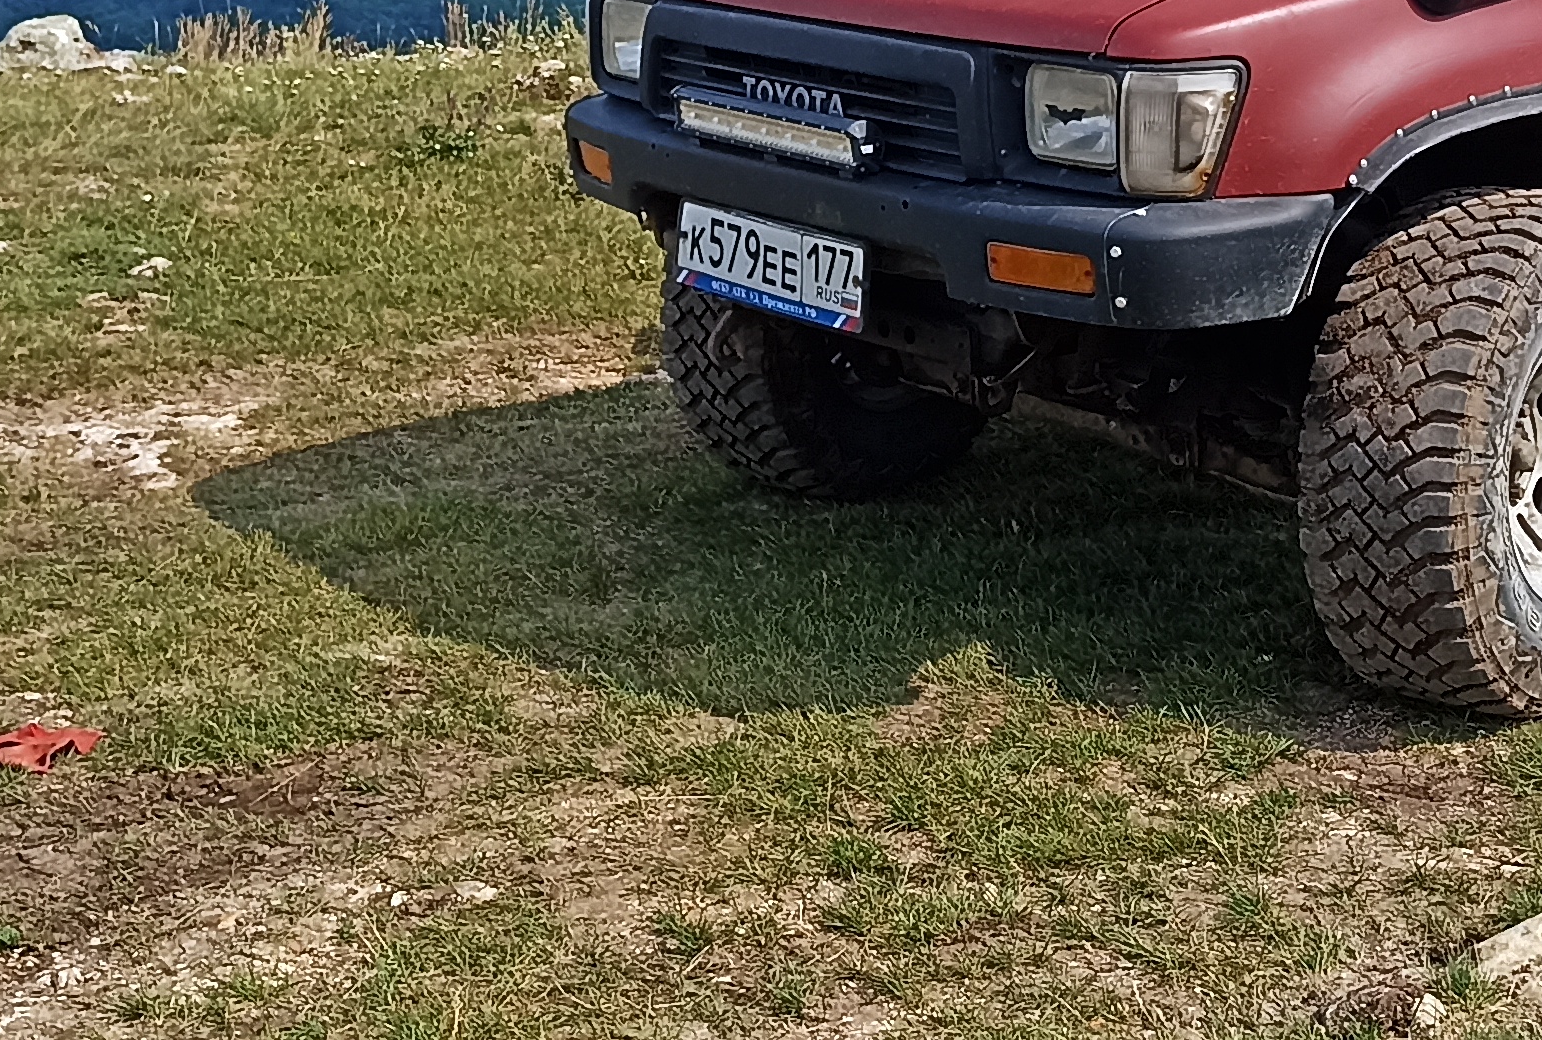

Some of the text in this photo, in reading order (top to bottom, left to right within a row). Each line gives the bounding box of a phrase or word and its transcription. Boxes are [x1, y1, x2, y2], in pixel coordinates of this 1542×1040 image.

[743, 76, 844, 117] TOYOTA
[806, 242, 855, 290] 177
[815, 285, 841, 305] RUS
